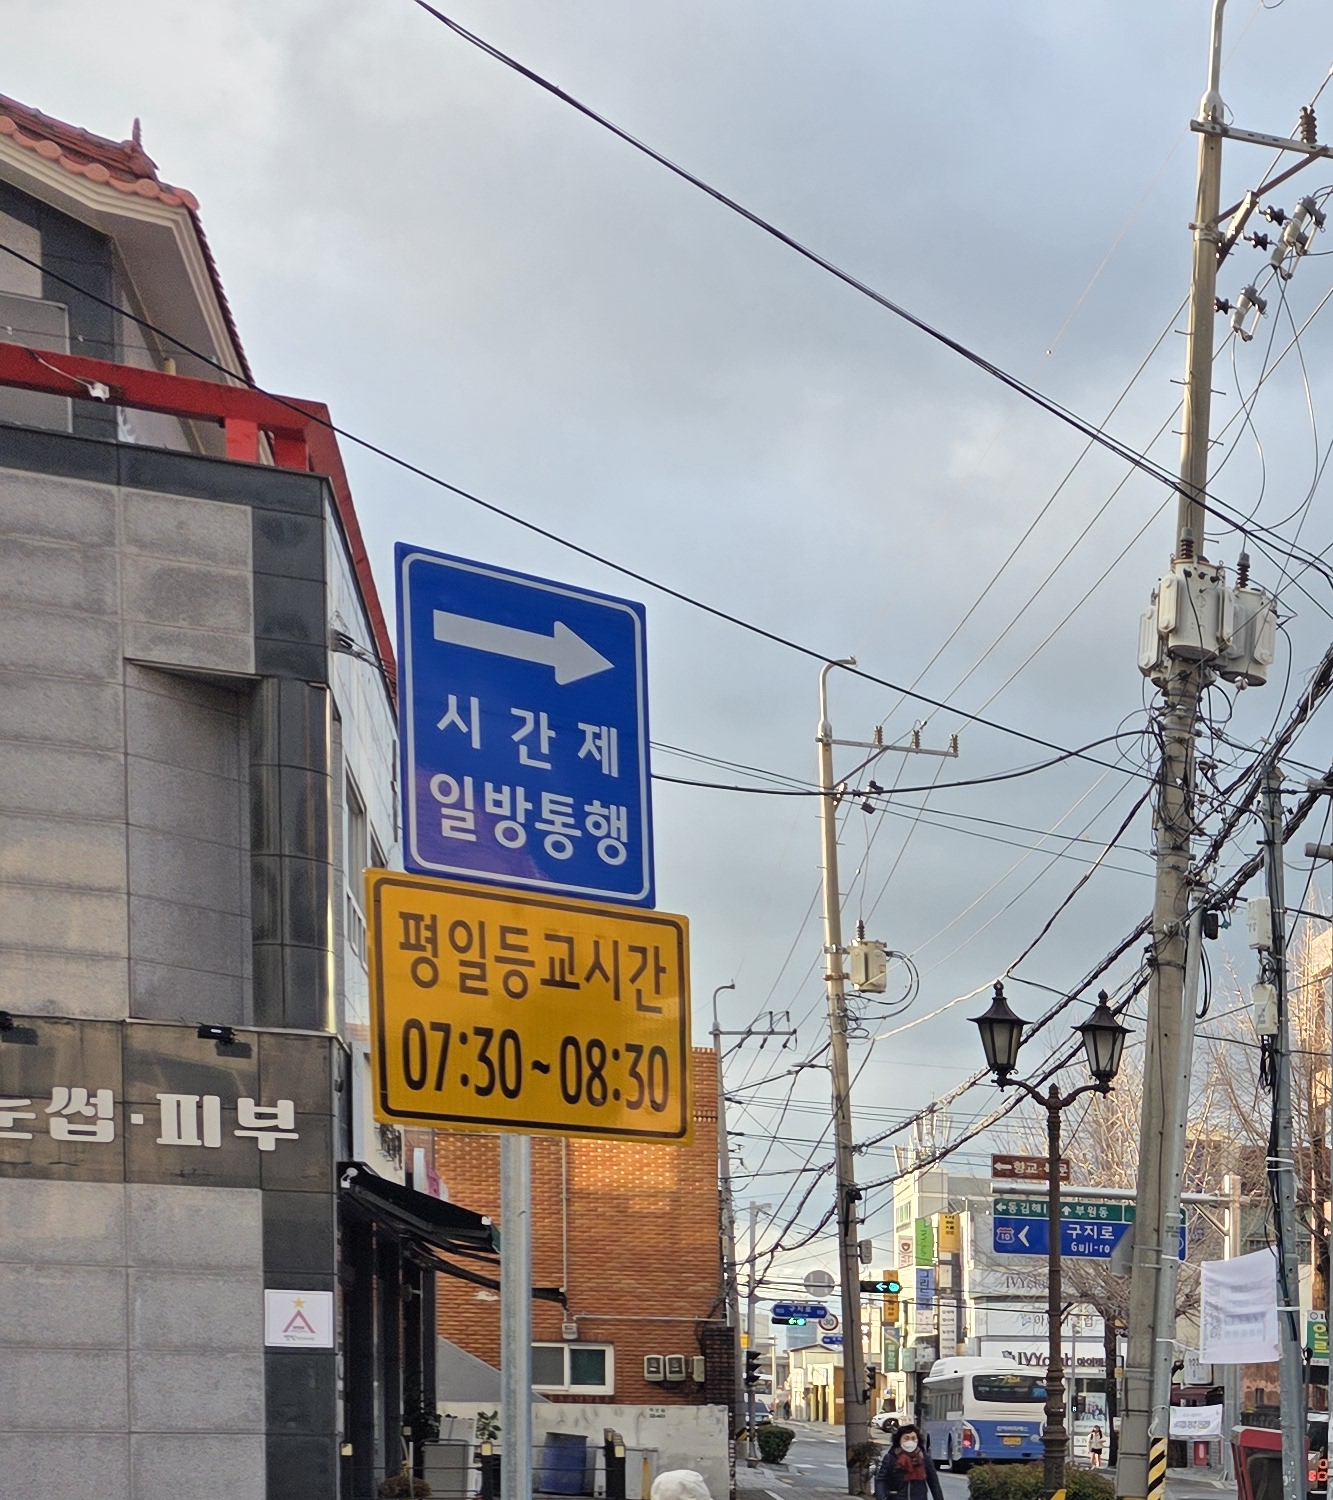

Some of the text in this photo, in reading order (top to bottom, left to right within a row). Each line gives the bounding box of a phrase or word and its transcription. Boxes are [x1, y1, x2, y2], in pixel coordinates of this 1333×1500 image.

[430, 772, 628, 867] 일방통행
[398, 910, 667, 1016] 평일등교시간
[1007, 1201, 1047, 1215] 동김해I
[1075, 1206, 1109, 1219] 부원동
[1066, 1223, 1115, 1241] 구지로
[1070, 1240, 1111, 1255] Guji-ro
